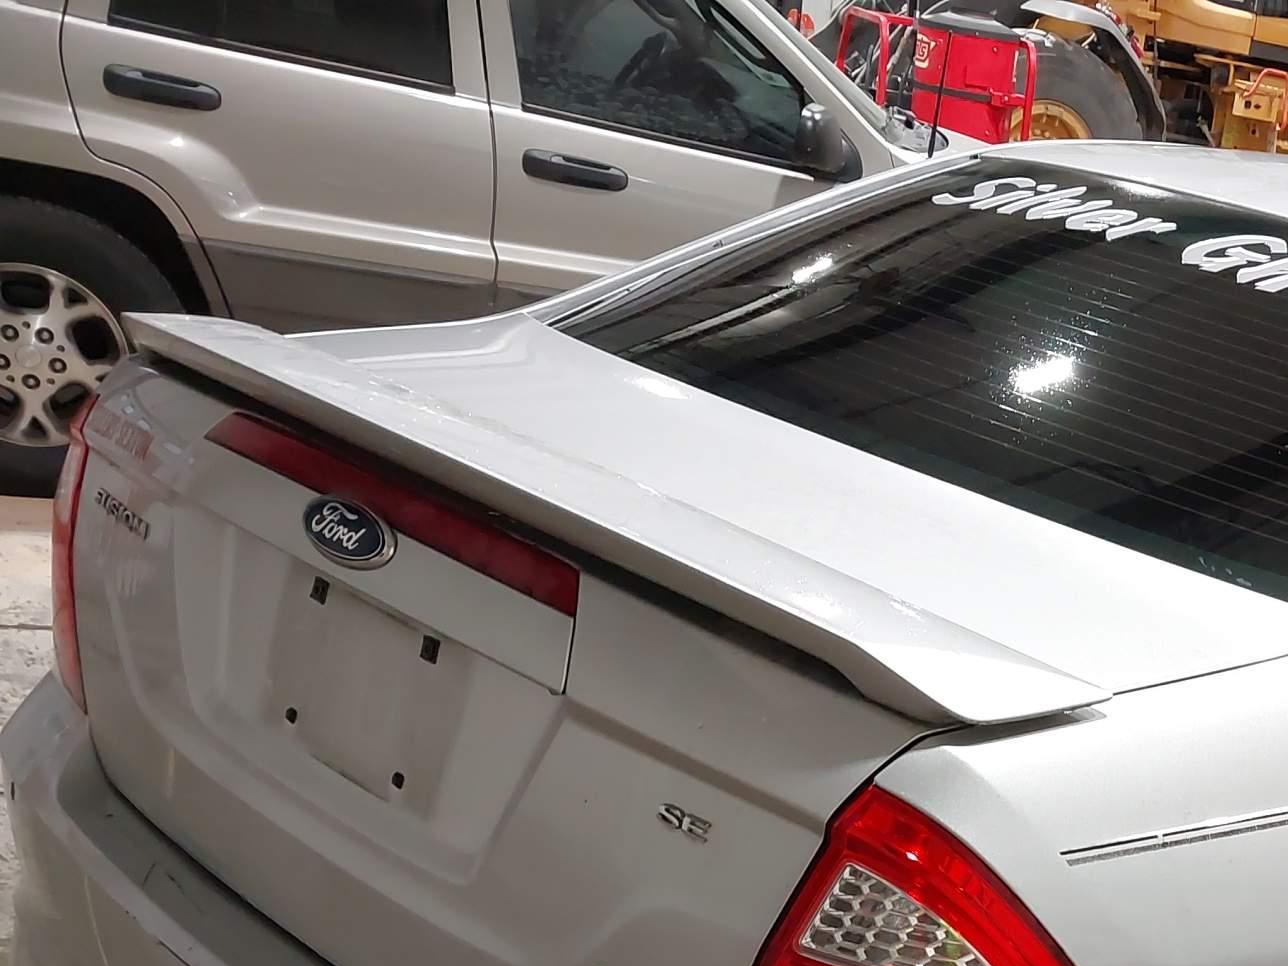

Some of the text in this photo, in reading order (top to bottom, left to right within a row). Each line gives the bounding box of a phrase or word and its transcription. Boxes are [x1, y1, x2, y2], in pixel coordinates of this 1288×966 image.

[931, 176, 1177, 242] Silver
[311, 502, 367, 551] Ford
[658, 803, 712, 843] SE
